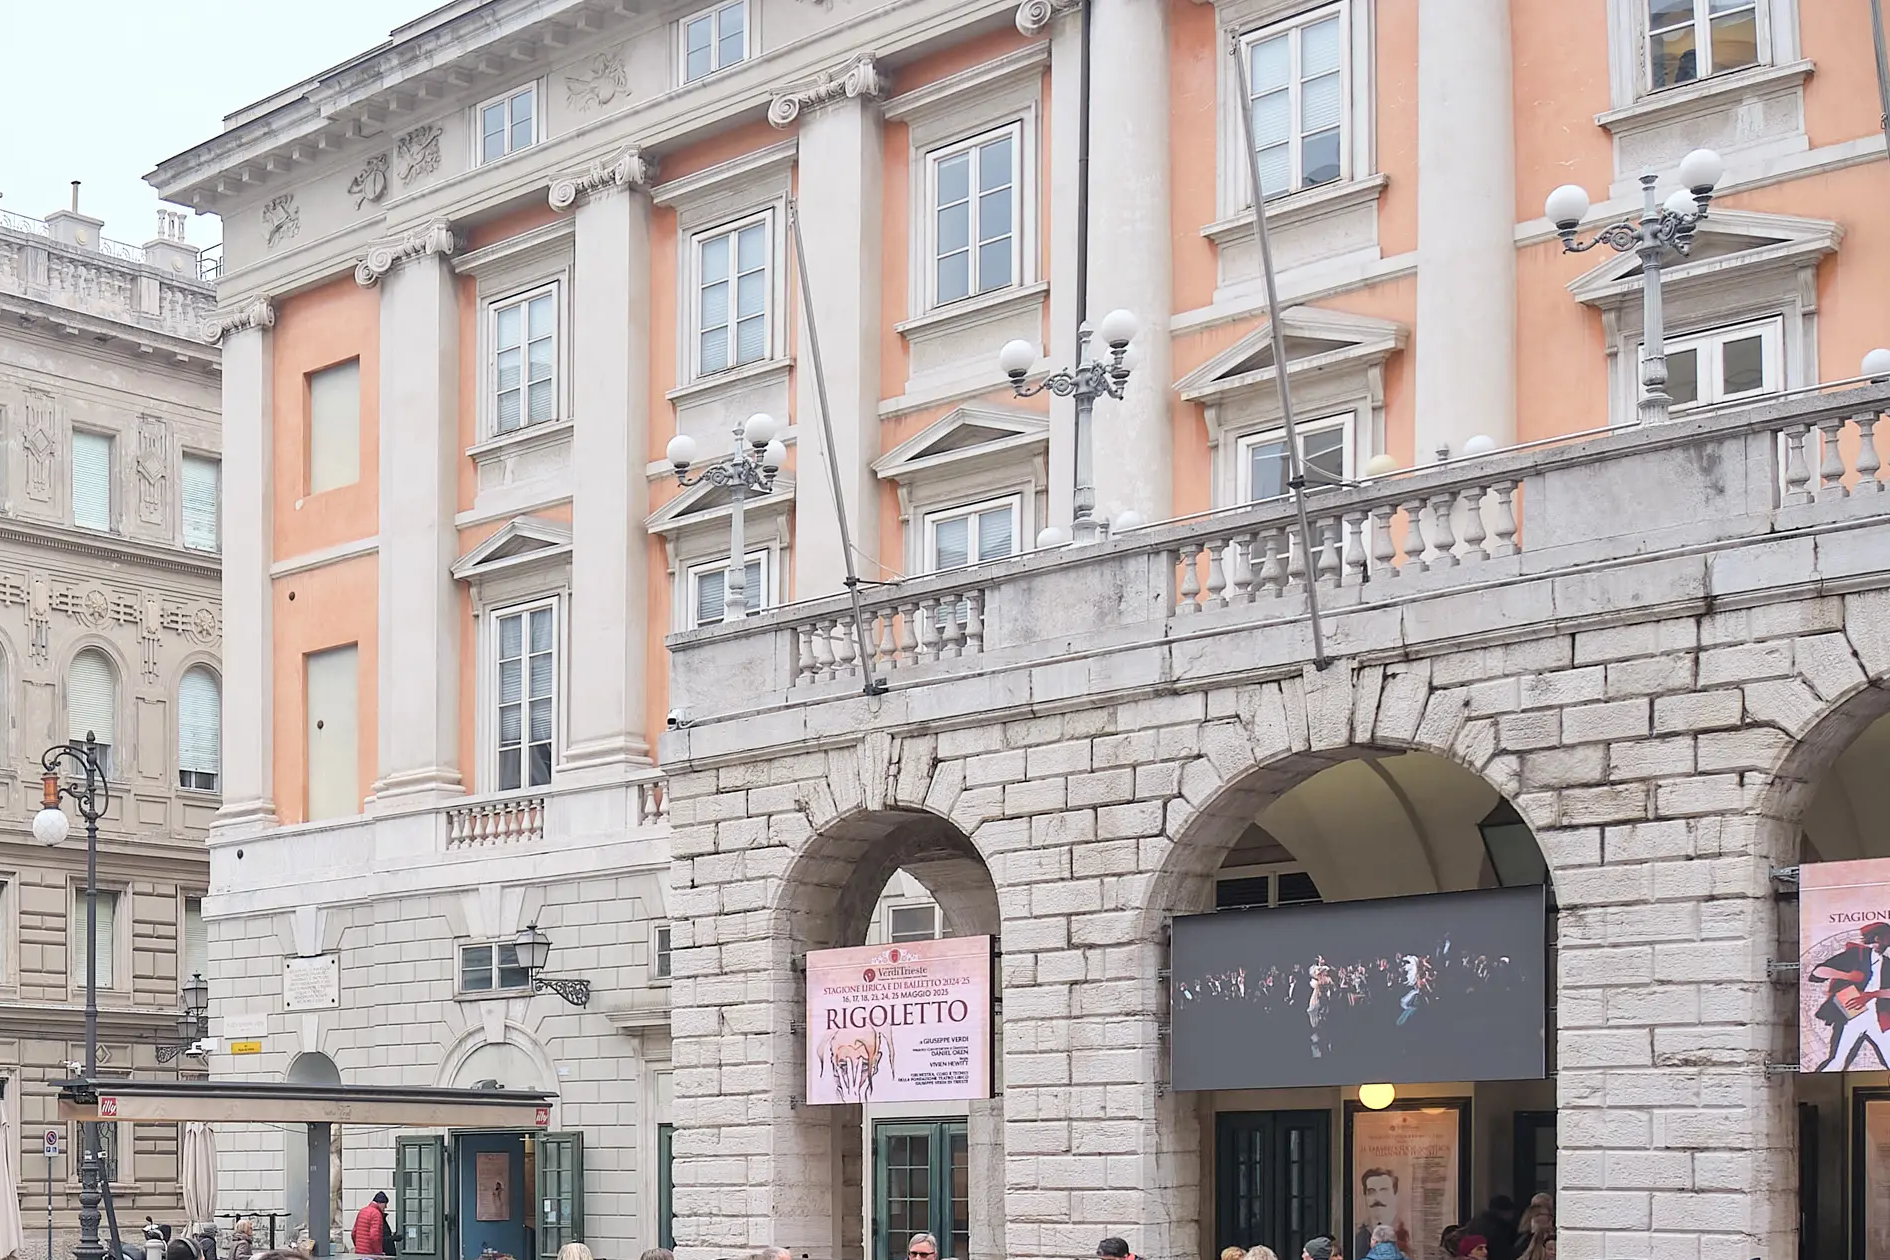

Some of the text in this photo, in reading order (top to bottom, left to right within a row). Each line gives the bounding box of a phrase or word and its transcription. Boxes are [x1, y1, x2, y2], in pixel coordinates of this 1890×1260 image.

[824, 985, 861, 995] STAGIONE
[862, 982, 886, 993] LIRICA
[887, 982, 893, 990] E
[893, 982, 902, 990] DI
[904, 979, 942, 989] BALLETTO
[900, 989, 931, 998] MAGGIO
[933, 988, 949, 996] 2025
[826, 999, 968, 1030] RIGOLETTO
[102, 1100, 116, 1115] illy
[536, 1110, 548, 1123] illy
